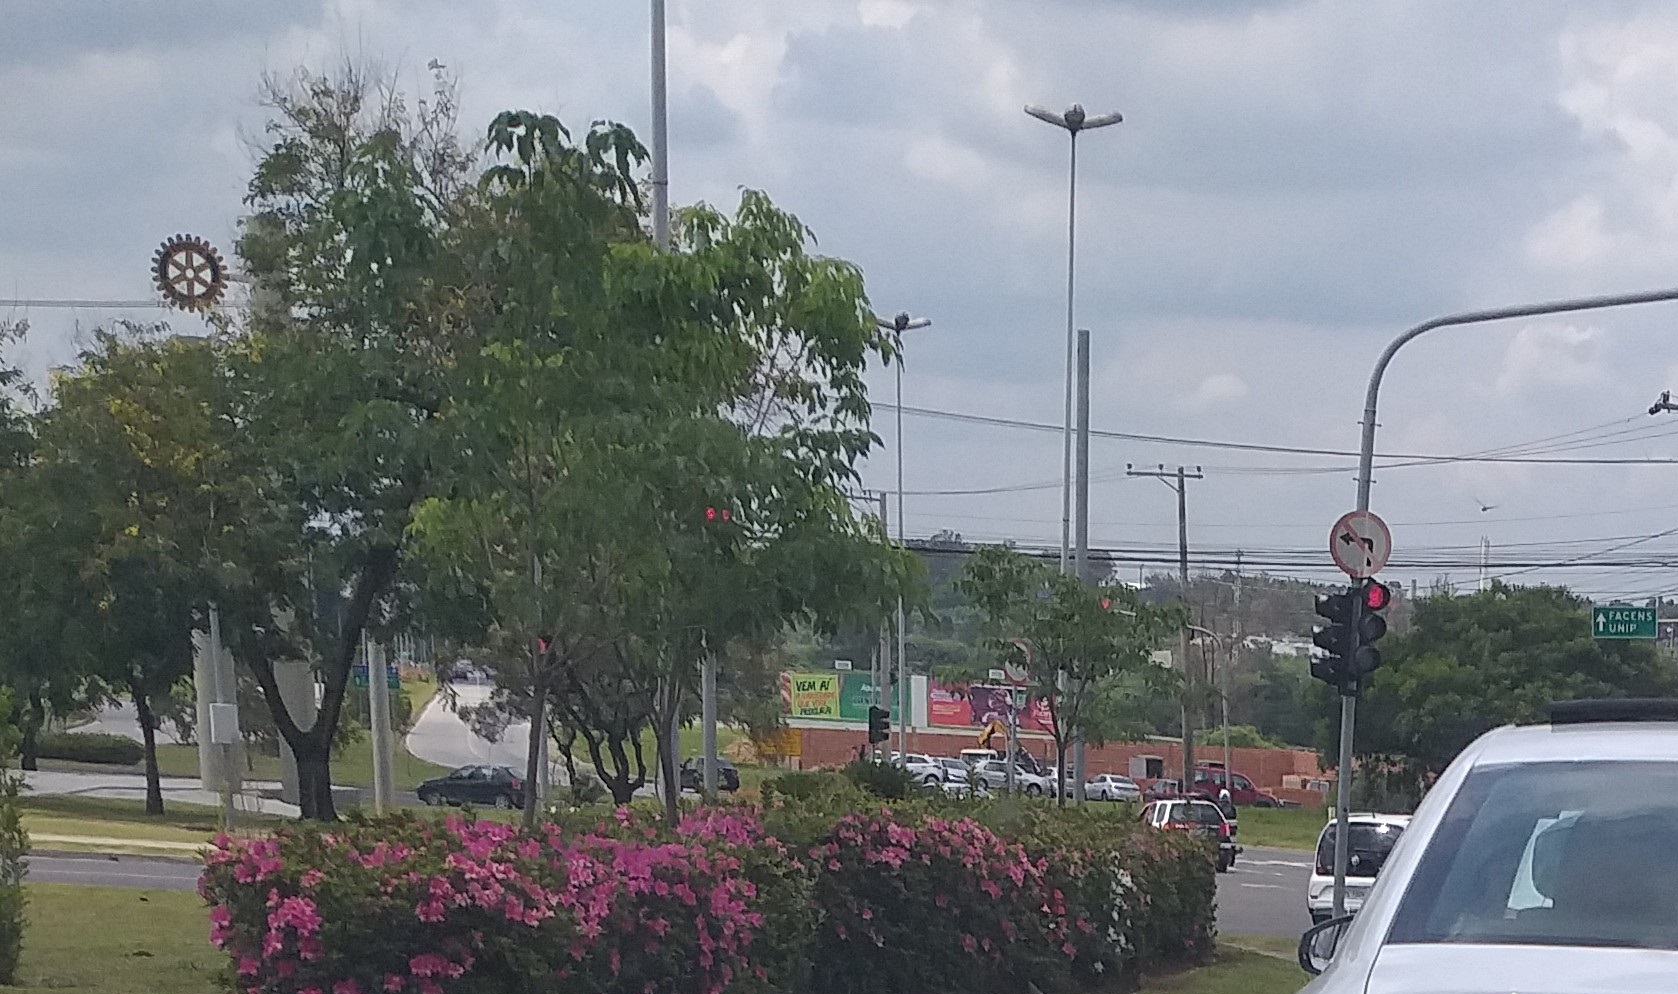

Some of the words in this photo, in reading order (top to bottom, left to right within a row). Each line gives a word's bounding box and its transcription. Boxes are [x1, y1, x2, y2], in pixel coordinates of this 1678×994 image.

[1608, 610, 1654, 622] FACENS
[1608, 622, 1638, 634] UNIP
[795, 680, 817, 692] VEM
